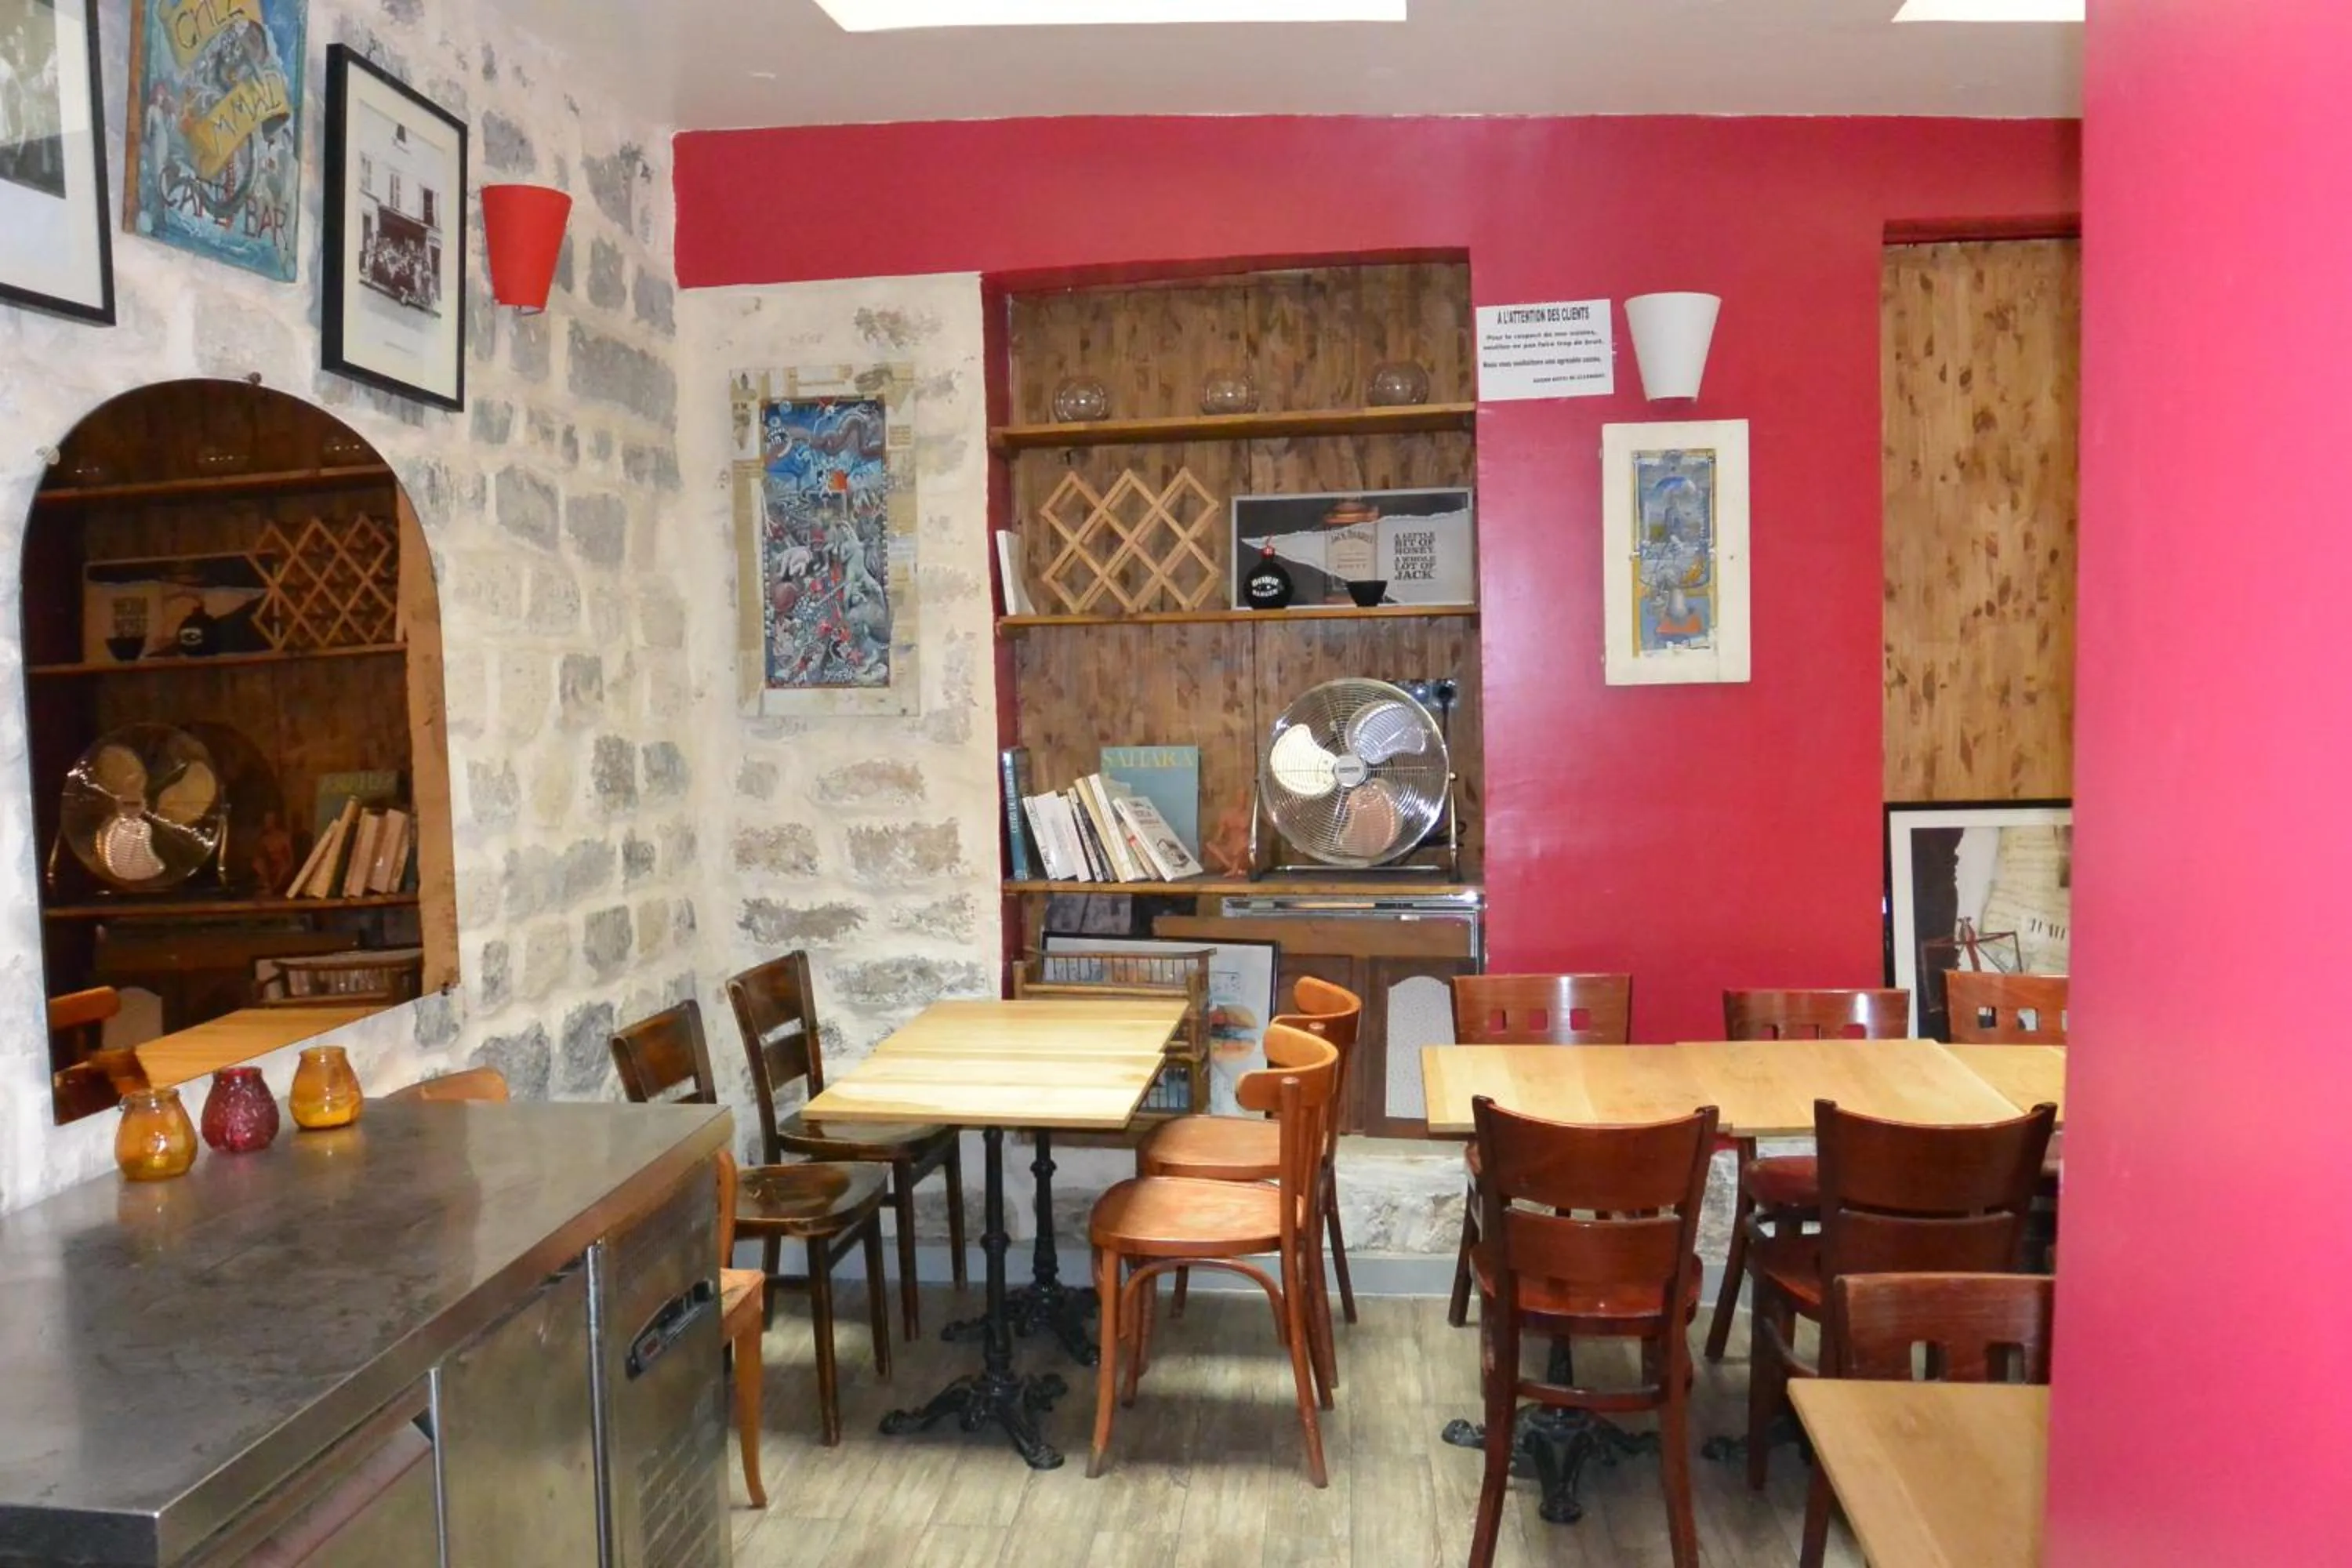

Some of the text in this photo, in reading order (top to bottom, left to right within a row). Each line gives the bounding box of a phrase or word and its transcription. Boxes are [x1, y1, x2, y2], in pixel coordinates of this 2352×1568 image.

[1548, 307, 1560, 322] DES
[1562, 304, 1590, 321] CLIENTS
[1101, 749, 1196, 768] SAHARA
